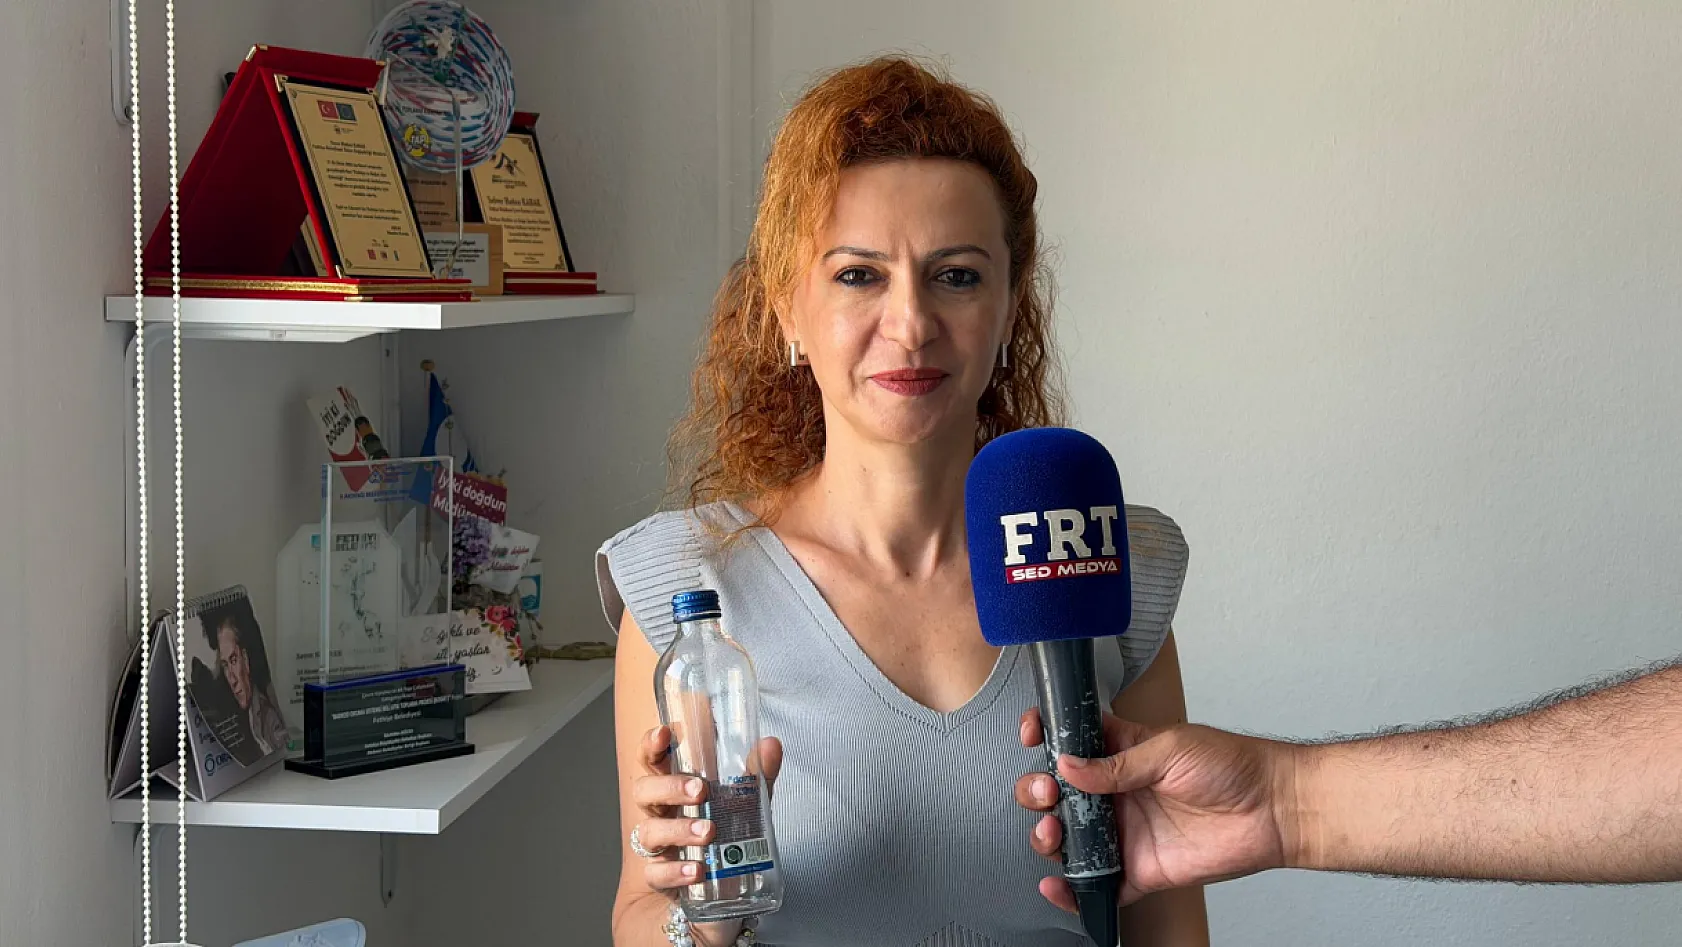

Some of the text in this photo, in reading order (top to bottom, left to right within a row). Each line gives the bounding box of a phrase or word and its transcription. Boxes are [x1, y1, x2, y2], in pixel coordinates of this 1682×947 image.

[462, 482, 507, 513] doğdun
[1001, 505, 1118, 566] FRT
[1011, 560, 1118, 581] SED MEDYA
[466, 626, 480, 637] ve
